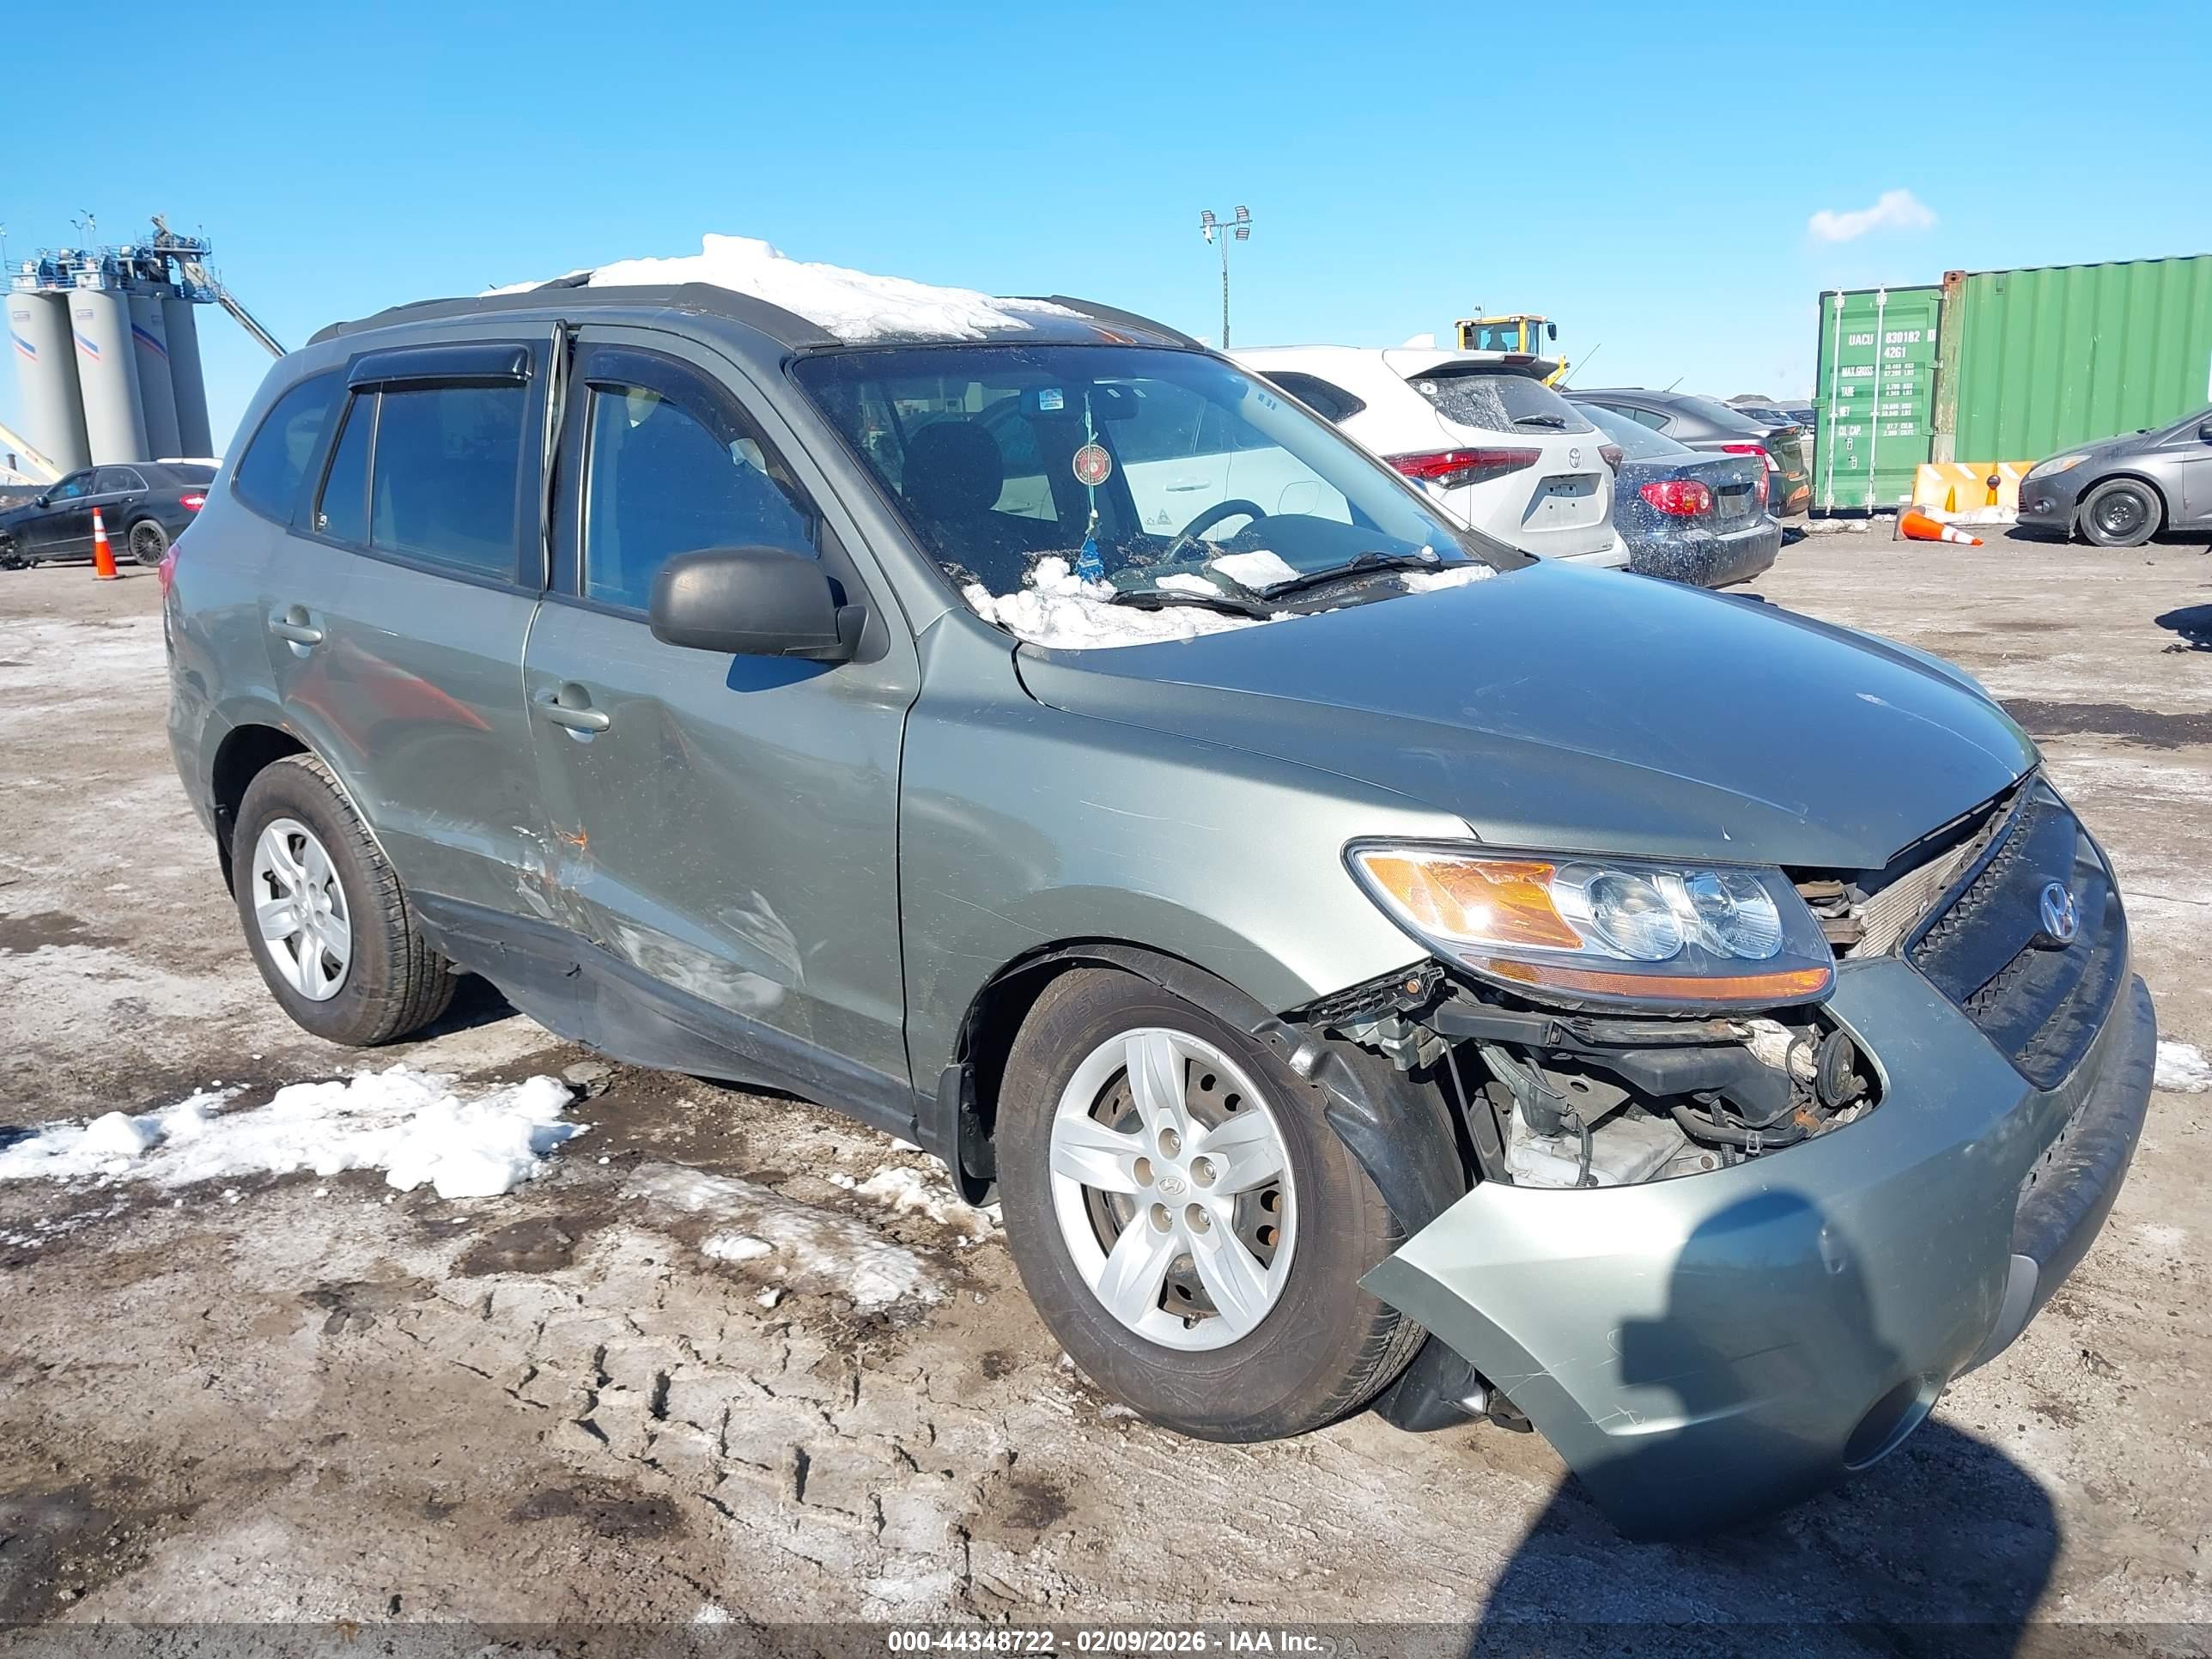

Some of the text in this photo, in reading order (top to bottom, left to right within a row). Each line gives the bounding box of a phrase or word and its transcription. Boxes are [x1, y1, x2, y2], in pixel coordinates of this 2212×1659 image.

[1849, 333, 1874, 345] UACU
[1886, 331, 1920, 343] 830182
[1841, 386, 1855, 397] TARE
[1839, 406, 1850, 416] NET
